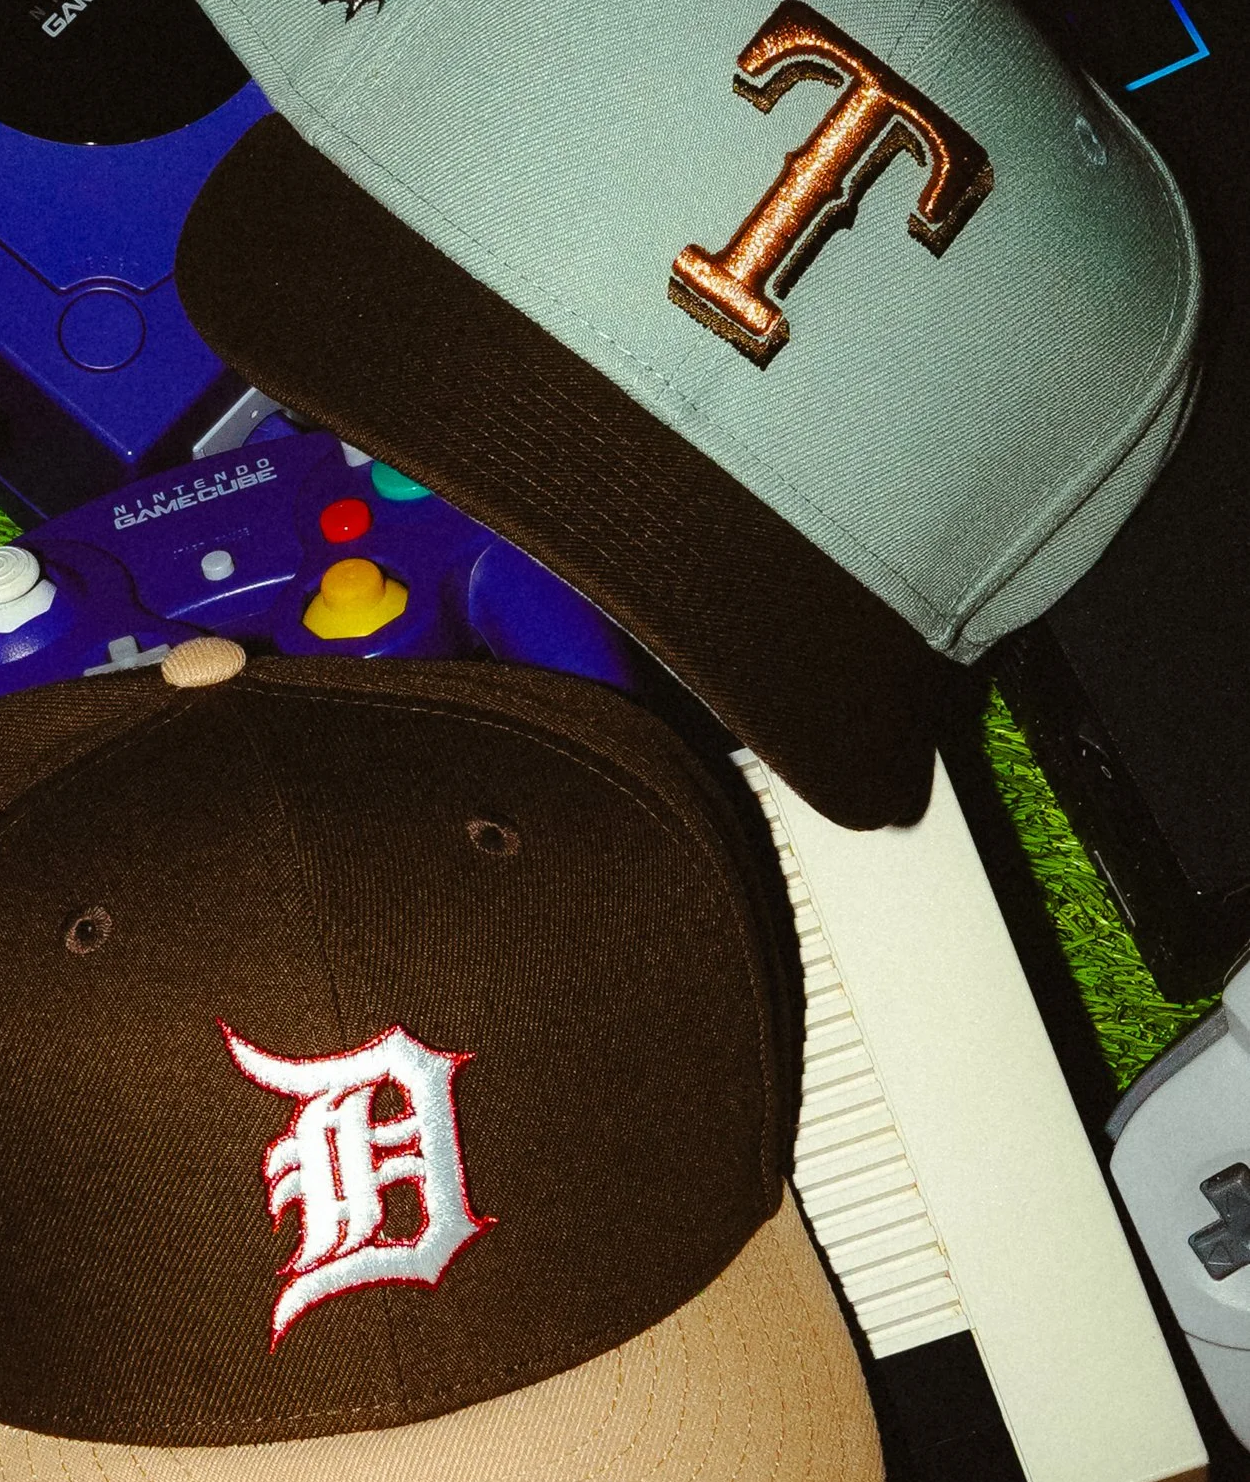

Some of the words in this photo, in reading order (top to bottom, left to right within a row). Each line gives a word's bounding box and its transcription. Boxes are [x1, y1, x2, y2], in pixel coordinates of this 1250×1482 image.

[112, 458, 271, 517] NINTENDO
[113, 465, 278, 531] GAMECUBE
[215, 1016, 500, 1355] D
